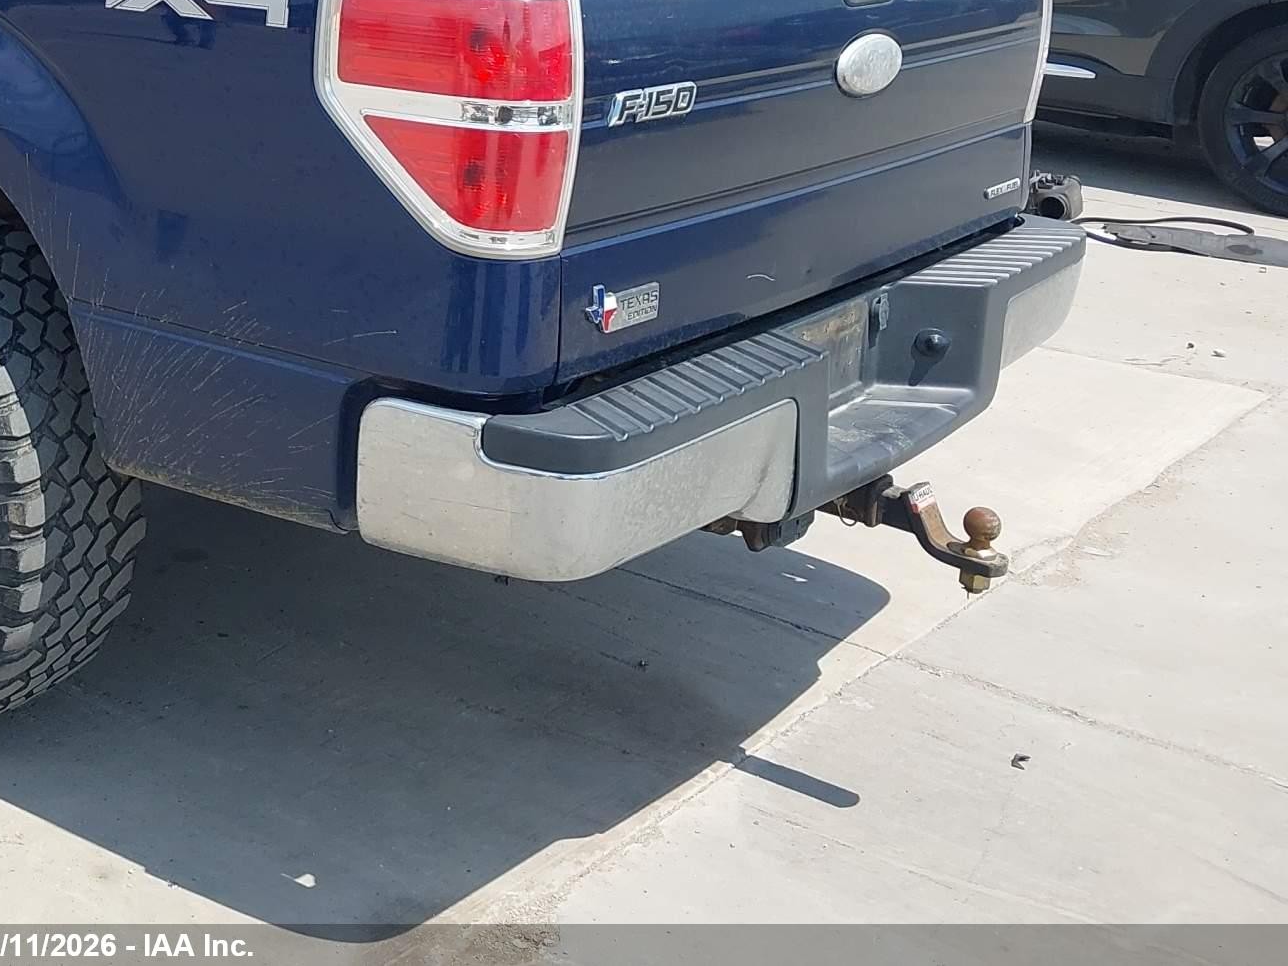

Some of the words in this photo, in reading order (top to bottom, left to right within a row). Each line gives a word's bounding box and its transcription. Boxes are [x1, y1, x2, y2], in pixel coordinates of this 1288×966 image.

[607, 80, 697, 128] F-150
[619, 289, 659, 311] TEXAS
[627, 305, 657, 321] EDITION
